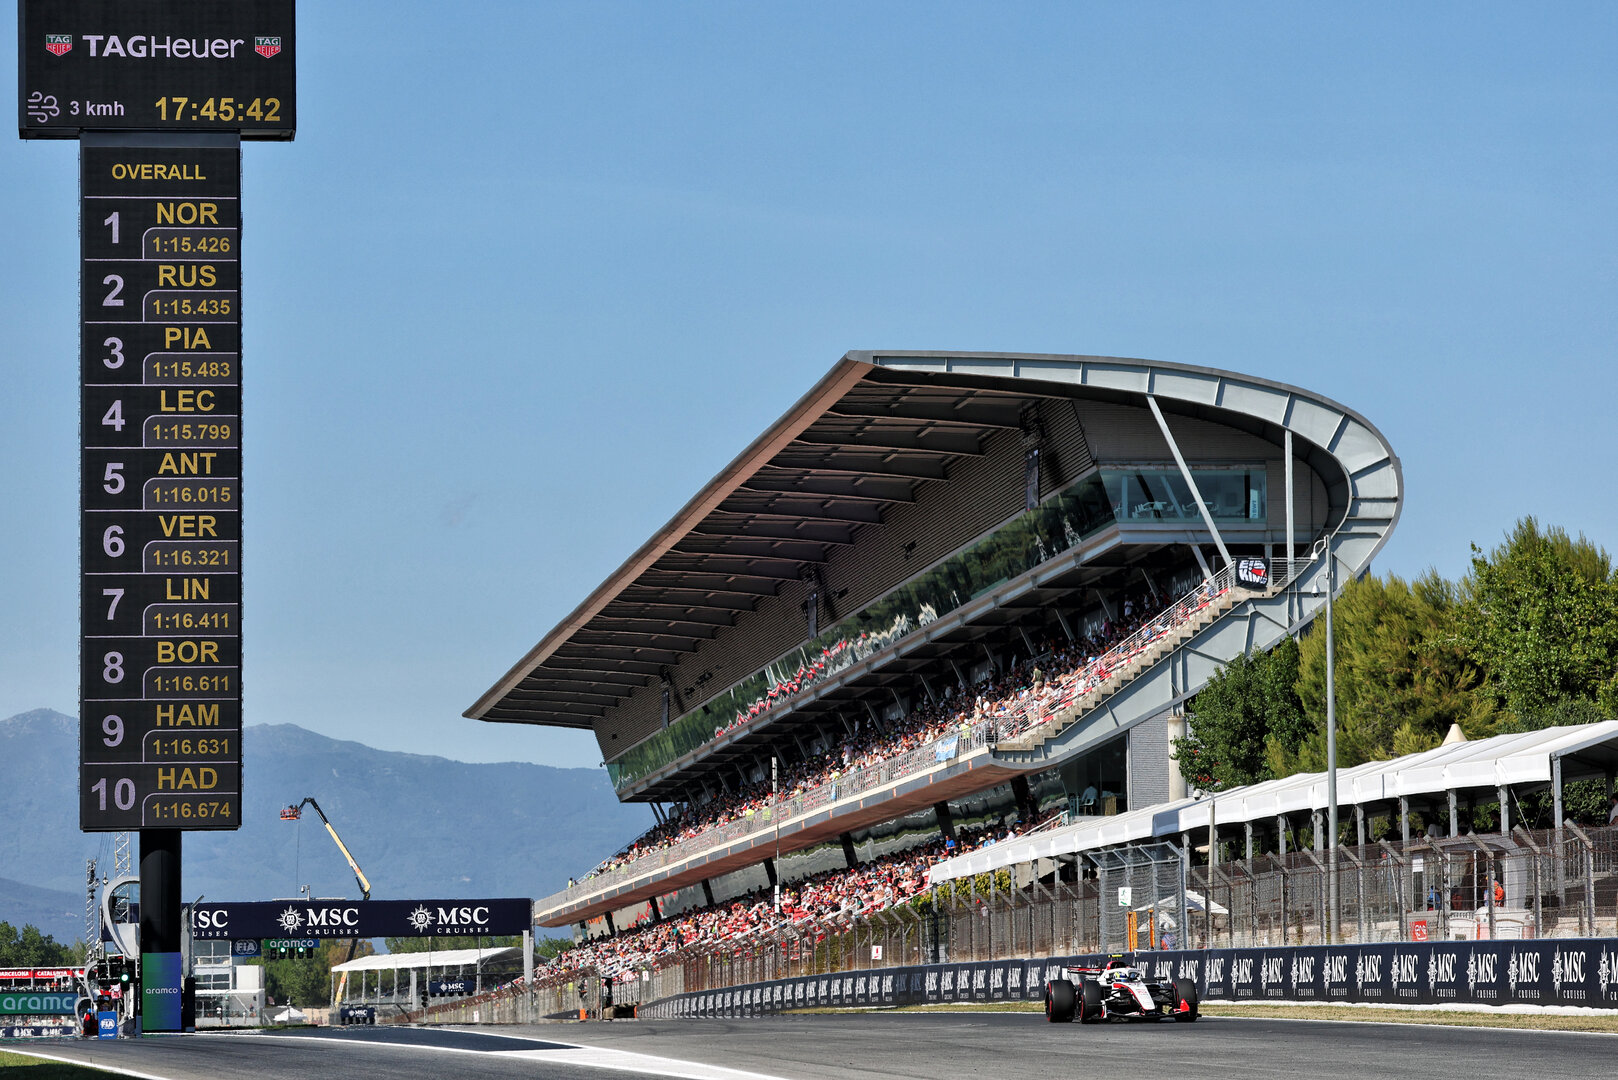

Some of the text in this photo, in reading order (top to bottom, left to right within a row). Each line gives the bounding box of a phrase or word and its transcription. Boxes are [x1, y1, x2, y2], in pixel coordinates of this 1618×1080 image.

[70, 101, 125, 116] 3 kmh
[155, 96, 281, 121] 17:45:42
[111, 163, 206, 180] OVERALL
[156, 202, 219, 225] NOR
[104, 211, 120, 244] 1
[152, 236, 231, 253] 1:15.426
[158, 264, 217, 287] RUS
[102, 274, 125, 307] 2
[153, 299, 231, 315] 1:15.435
[165, 327, 212, 349] PIA
[102, 336, 125, 369] 3
[153, 361, 231, 378] 1:15.483
[160, 389, 215, 412] LEC
[101, 399, 126, 432] 4
[153, 424, 231, 440] 1:15.799
[157, 452, 217, 475] ANT
[103, 462, 125, 495] 5
[153, 486, 231, 503] 1:16.015
[158, 515, 218, 537] VER
[102, 524, 126, 558] 6
[153, 549, 229, 566] 1:16.321
[166, 578, 209, 600] LIN
[102, 588, 125, 621] 7
[153, 612, 228, 629] 1:16.411
[157, 640, 220, 663] BOR
[102, 651, 125, 684] 8
[154, 675, 228, 692] 1:16.611
[156, 703, 219, 727] HAM
[102, 714, 125, 748] 9
[153, 738, 228, 755] 1:16.631
[157, 766, 218, 790] HAD
[91, 777, 136, 811] 10
[152, 802, 231, 819] 1:16.674
[306, 908, 359, 927] MSC
[436, 907, 489, 925] MSC
[270, 940, 314, 948] aramco
[1267, 957, 1284, 983] MSC
[1298, 956, 1315, 983] MSC
[1331, 955, 1348, 982] MSC
[1364, 954, 1382, 982] MSC
[1400, 954, 1418, 983] MSC
[1436, 953, 1457, 983] MSC
[1476, 953, 1498, 983] MSC
[1518, 952, 1540, 983] MSC
[1563, 951, 1586, 983] MSC
[3, 996, 76, 1010] aramc
[1436, 988, 1457, 997] CRUISES
[1476, 989, 1497, 998] CRUISES
[1518, 989, 1540, 999] CRUISES
[1563, 989, 1586, 1000] CRUISES
